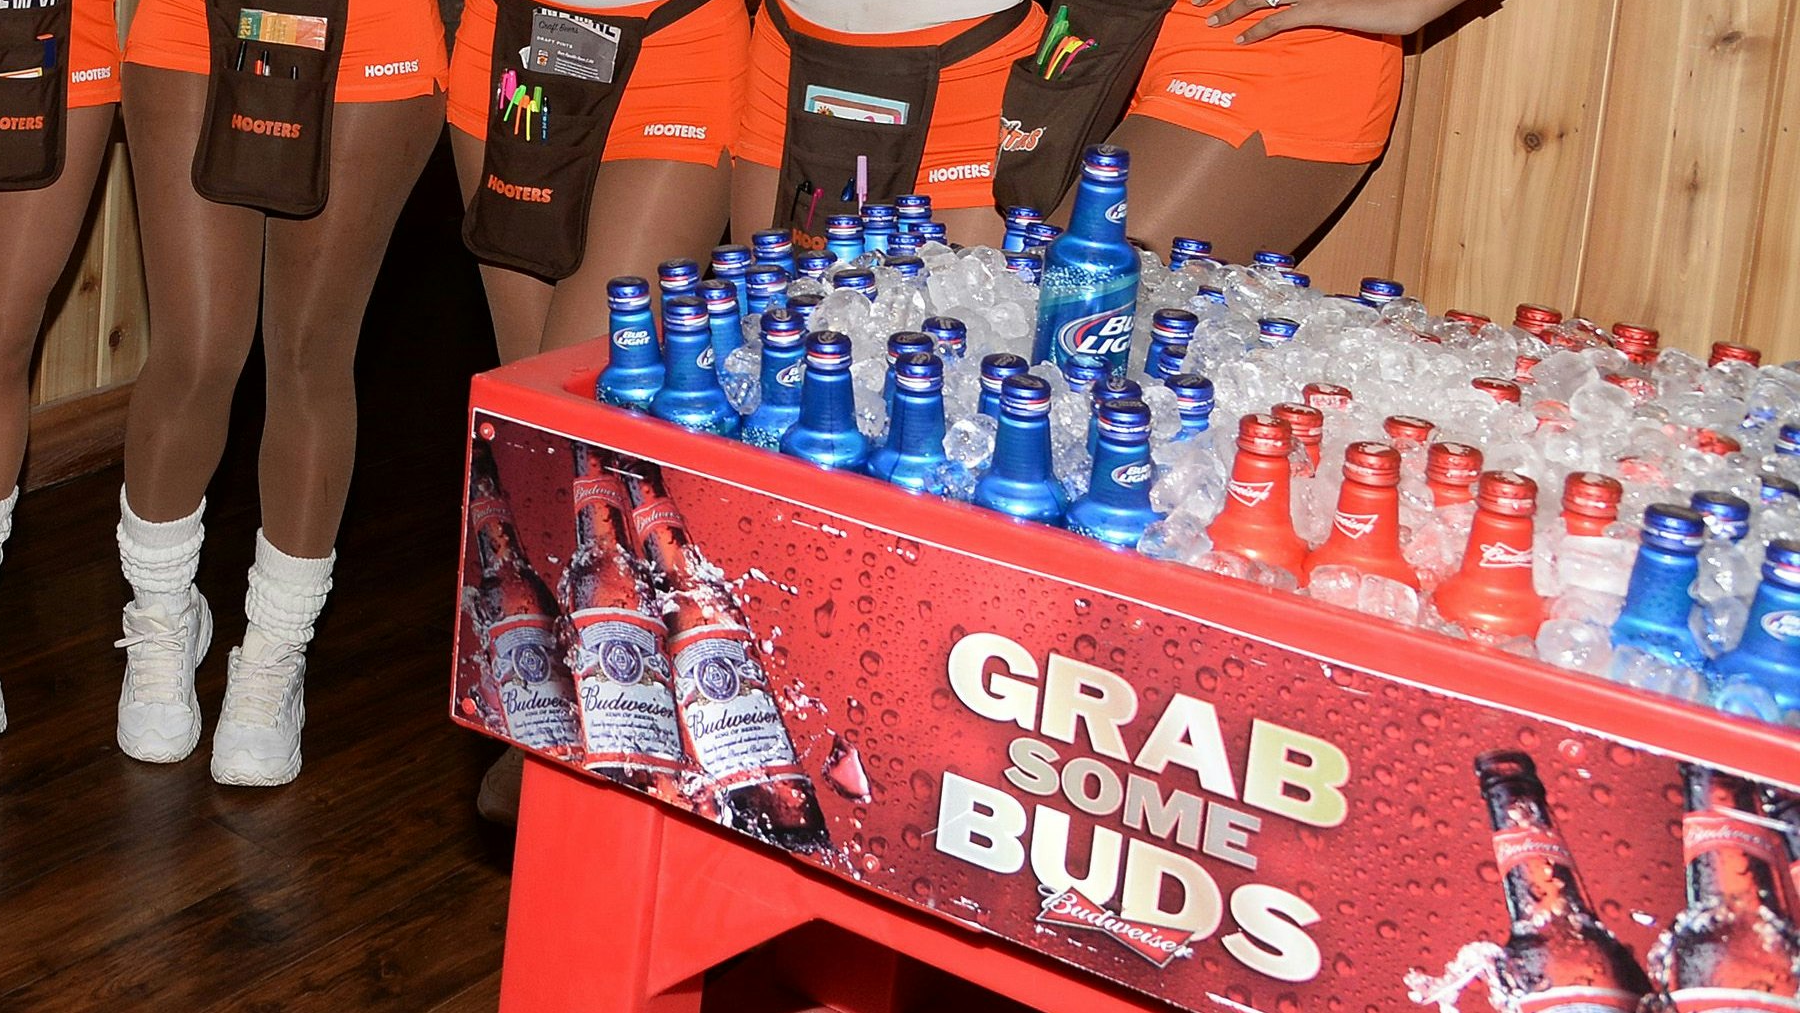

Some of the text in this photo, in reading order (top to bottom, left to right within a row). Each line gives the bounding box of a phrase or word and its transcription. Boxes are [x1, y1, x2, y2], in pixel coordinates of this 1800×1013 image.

[536, 36, 573, 49] DRAFT PINTS
[71, 67, 110, 83] HOOTERS
[365, 60, 417, 78] HOOTERS
[1165, 78, 1235, 108] HOOTERS
[231, 113, 301, 139] HOOTERS
[644, 124, 707, 139] HOOTERS
[928, 163, 991, 183] HOOTERS
[487, 174, 553, 204] HOOTERS
[1098, 315, 1134, 336] BU
[617, 336, 651, 345] LIGHT
[1076, 334, 1131, 354] LIG
[581, 684, 674, 718] Budweiser
[687, 706, 778, 741] Budweiser
[948, 632, 1351, 828] GRAB
[1004, 737, 1262, 871] SOME
[936, 771, 1322, 982] BUDS
[1038, 884, 1194, 959] Budweiser
